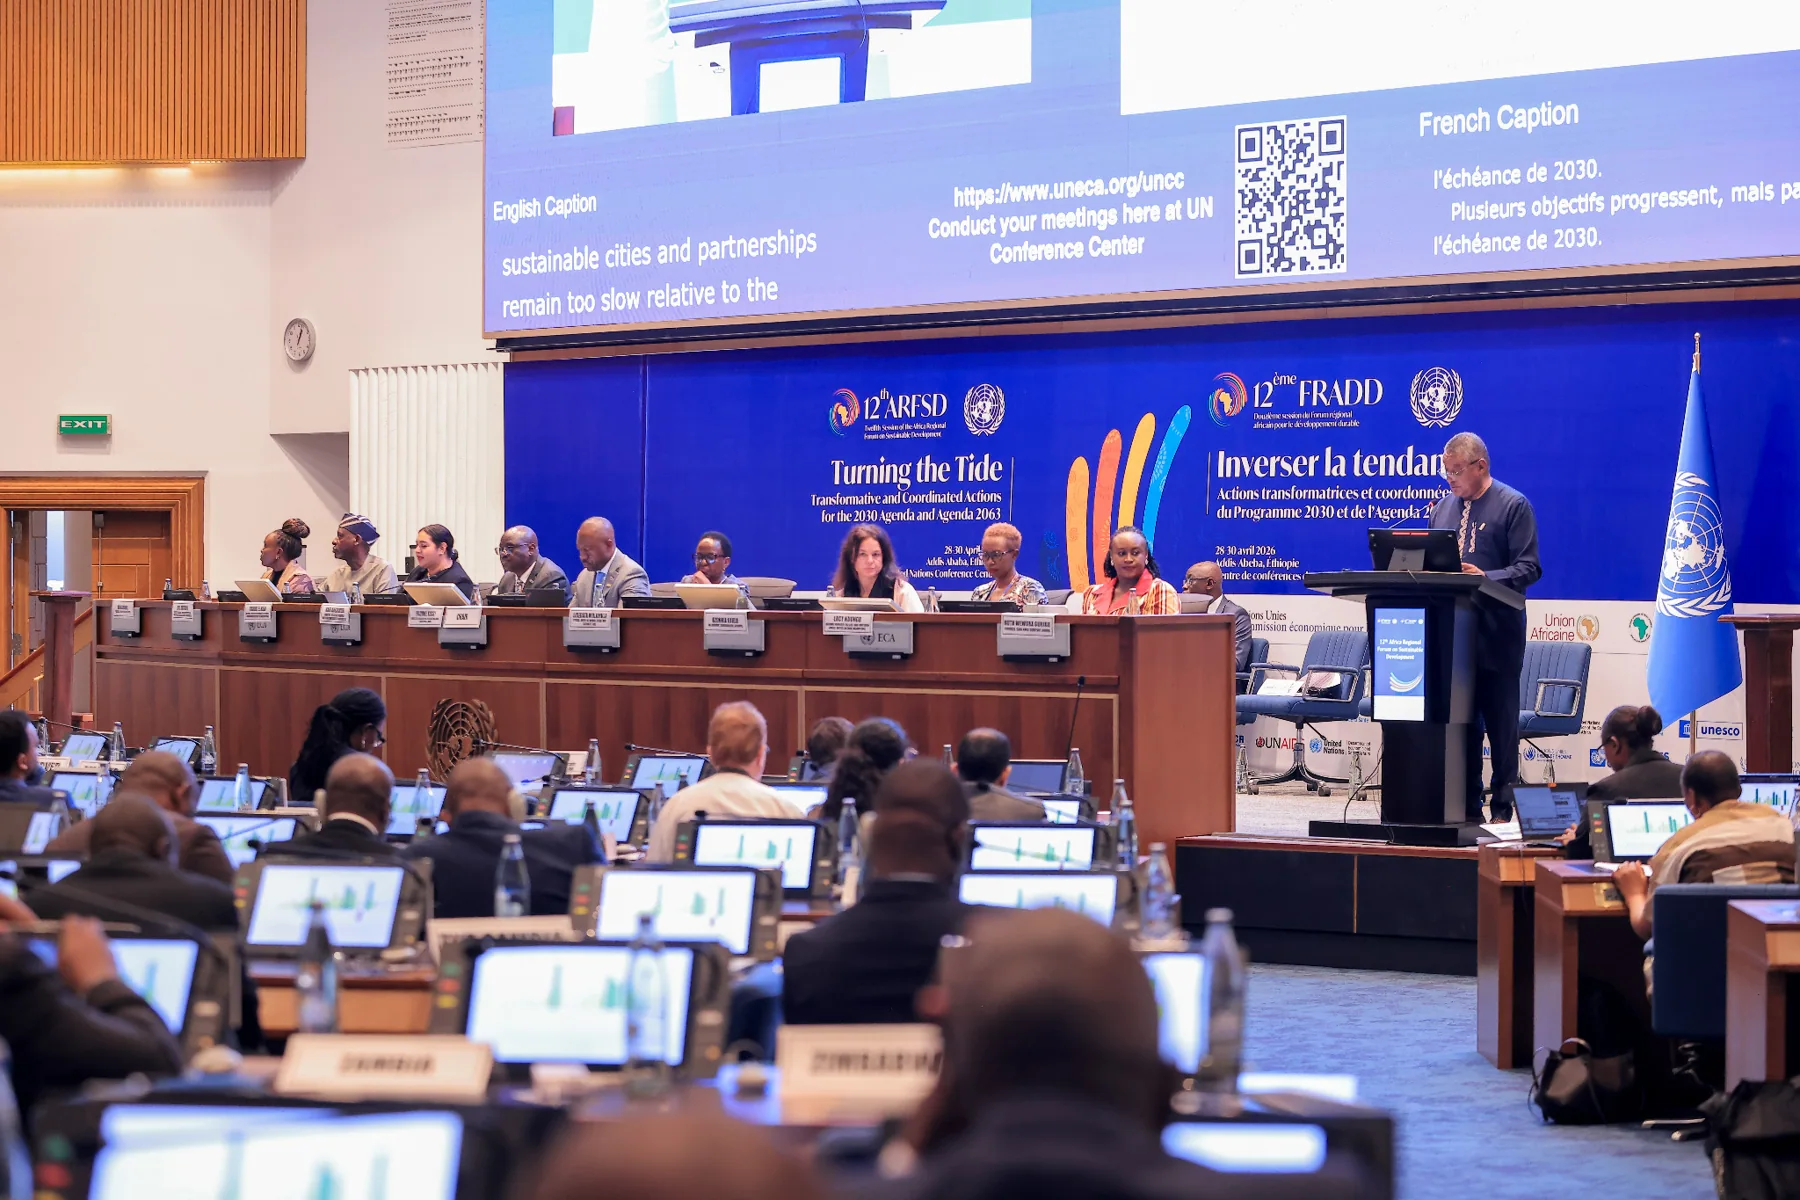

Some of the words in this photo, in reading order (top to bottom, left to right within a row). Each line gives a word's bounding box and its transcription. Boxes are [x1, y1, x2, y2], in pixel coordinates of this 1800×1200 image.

[1420, 107, 1490, 137] French
[1497, 100, 1579, 134] Caption
[1434, 165, 1521, 190] l'échéance
[1527, 162, 1548, 183] de
[1554, 158, 1602, 181] 2030.
[953, 170, 1185, 210] https://www.uneca.org/uncc
[493, 198, 541, 224] English
[545, 193, 597, 219] Caption
[1452, 200, 1526, 221] Plusieurs
[1531, 191, 1605, 220] objectifs
[1611, 185, 1723, 216] progressent,
[1731, 181, 1775, 203] mais
[1781, 182, 1800, 205] pa
[928, 215, 996, 239] Conduct
[1000, 213, 1037, 238] your
[1041, 206, 1118, 231] meetings
[1123, 202, 1160, 224] here
[1165, 200, 1182, 221] at
[1187, 196, 1214, 220] UN
[1434, 232, 1521, 255] l'échéance
[1527, 229, 1548, 251] de
[1554, 226, 1602, 249] 2030.
[502, 245, 599, 276] sustainable
[605, 242, 651, 268] cities
[657, 237, 691, 264] and
[698, 229, 817, 266] partnerships
[990, 240, 1084, 264] Conference
[1088, 234, 1145, 257] Center
[503, 292, 561, 318] remain
[567, 291, 596, 314] too
[601, 286, 641, 311] slow
[648, 281, 715, 309] relative
[722, 279, 741, 302] to
[747, 276, 778, 301] the
[1299, 378, 1384, 407] FRADD
[884, 393, 948, 419] ARFSD
[1253, 411, 1281, 420] Douzième
[1281, 411, 1300, 420] session
[1300, 411, 1310, 419] du
[1310, 410, 1329, 419] Forum
[1329, 410, 1353, 419] régional
[61, 420, 106, 428] EXIT
[864, 424, 881, 432] Twelfth
[913, 422, 926, 430] Africa
[926, 422, 946, 431] Regional
[1253, 421, 1274, 429] africain
[1274, 421, 1287, 430] pour
[1294, 420, 1337, 430] développement
[1337, 420, 1360, 428] durable
[886, 431, 911, 440] Sustainable
[911, 431, 942, 439] Development
[1217, 450, 1320, 478] Inverser
[1324, 446, 1347, 477] la
[1353, 445, 1444, 478] tendan
[831, 455, 912, 491] Turning
[916, 454, 950, 484] the
[955, 453, 1003, 482] Tide
[811, 491, 881, 506] Transformative
[882, 491, 901, 505] and
[902, 489, 963, 505] Coordinated
[964, 489, 1002, 503] Actions
[1217, 485, 1260, 500] Actions
[1261, 484, 1359, 500] transformatrices
[1361, 487, 1373, 500] et
[821, 510, 835, 523] for
[837, 509, 852, 522] the
[853, 509, 878, 522] 2030
[879, 507, 915, 525] Agenda
[916, 507, 935, 521] and
[936, 506, 974, 524] Agenda
[975, 507, 1001, 521] 2063
[1217, 505, 1232, 519] du
[1233, 505, 1302, 522] Programme
[1304, 505, 1335, 519] 2030
[1336, 505, 1349, 519] et
[1351, 504, 1367, 519] de
[944, 545, 963, 555] 28-30
[1237, 544, 1255, 556] avril
[1255, 545, 1276, 556] 2026
[926, 556, 945, 566] Addis
[945, 556, 969, 568] Ababa,
[1237, 557, 1265, 569] Abeba,
[1266, 556, 1300, 570] Éthiopie
[909, 568, 934, 578] Nations
[934, 568, 974, 579] Conference
[1222, 571, 1240, 580] entre
[1241, 570, 1252, 580] de
[1252, 570, 1302, 580] conférences
[1249, 610, 1264, 621] ions
[1265, 610, 1287, 621] Unies
[1545, 613, 1575, 627] Union
[1251, 622, 1287, 632] mission
[1289, 621, 1341, 632] économique
[1343, 624, 1364, 632] pour
[1530, 627, 1575, 641] Africaine
[878, 633, 896, 642] ECA
[1701, 725, 1740, 737] unesco
